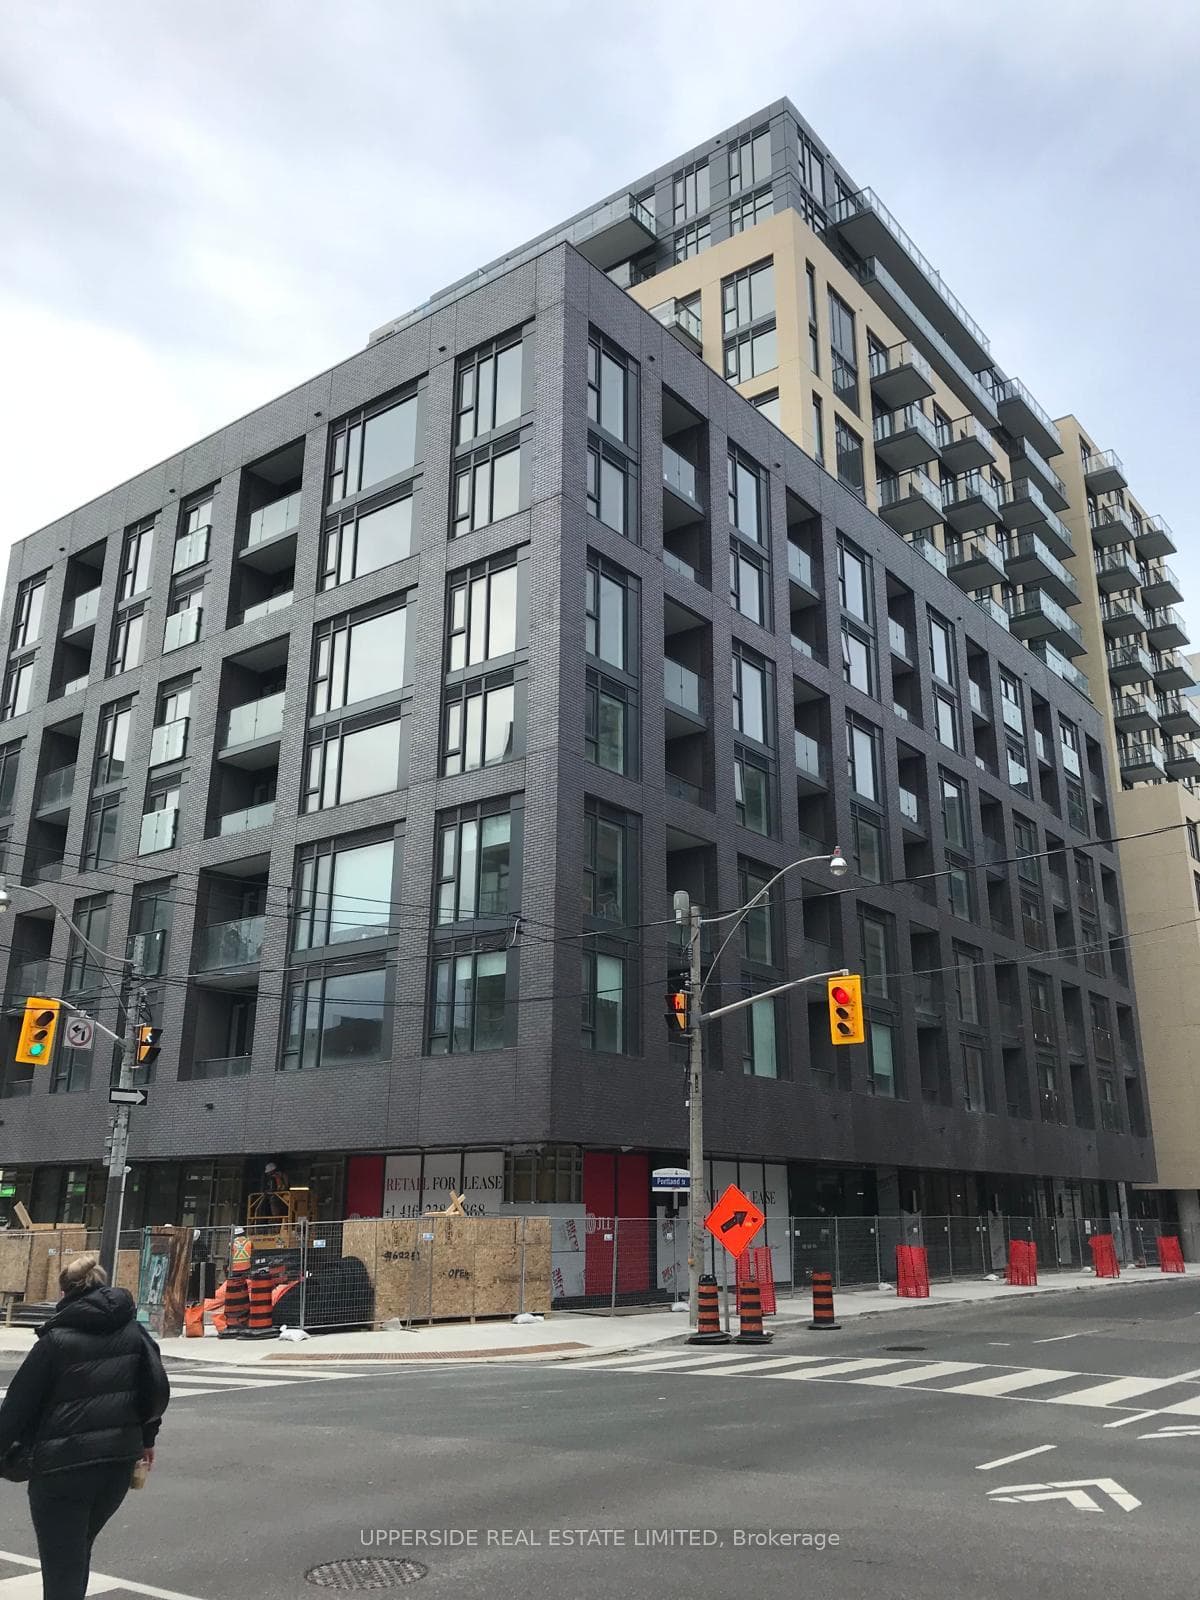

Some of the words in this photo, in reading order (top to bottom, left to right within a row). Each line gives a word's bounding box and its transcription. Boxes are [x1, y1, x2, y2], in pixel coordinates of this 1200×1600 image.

[386, 1177, 429, 1191] RETAIL
[433, 1176, 456, 1190] FOR
[464, 1175, 503, 1190] LEASE
